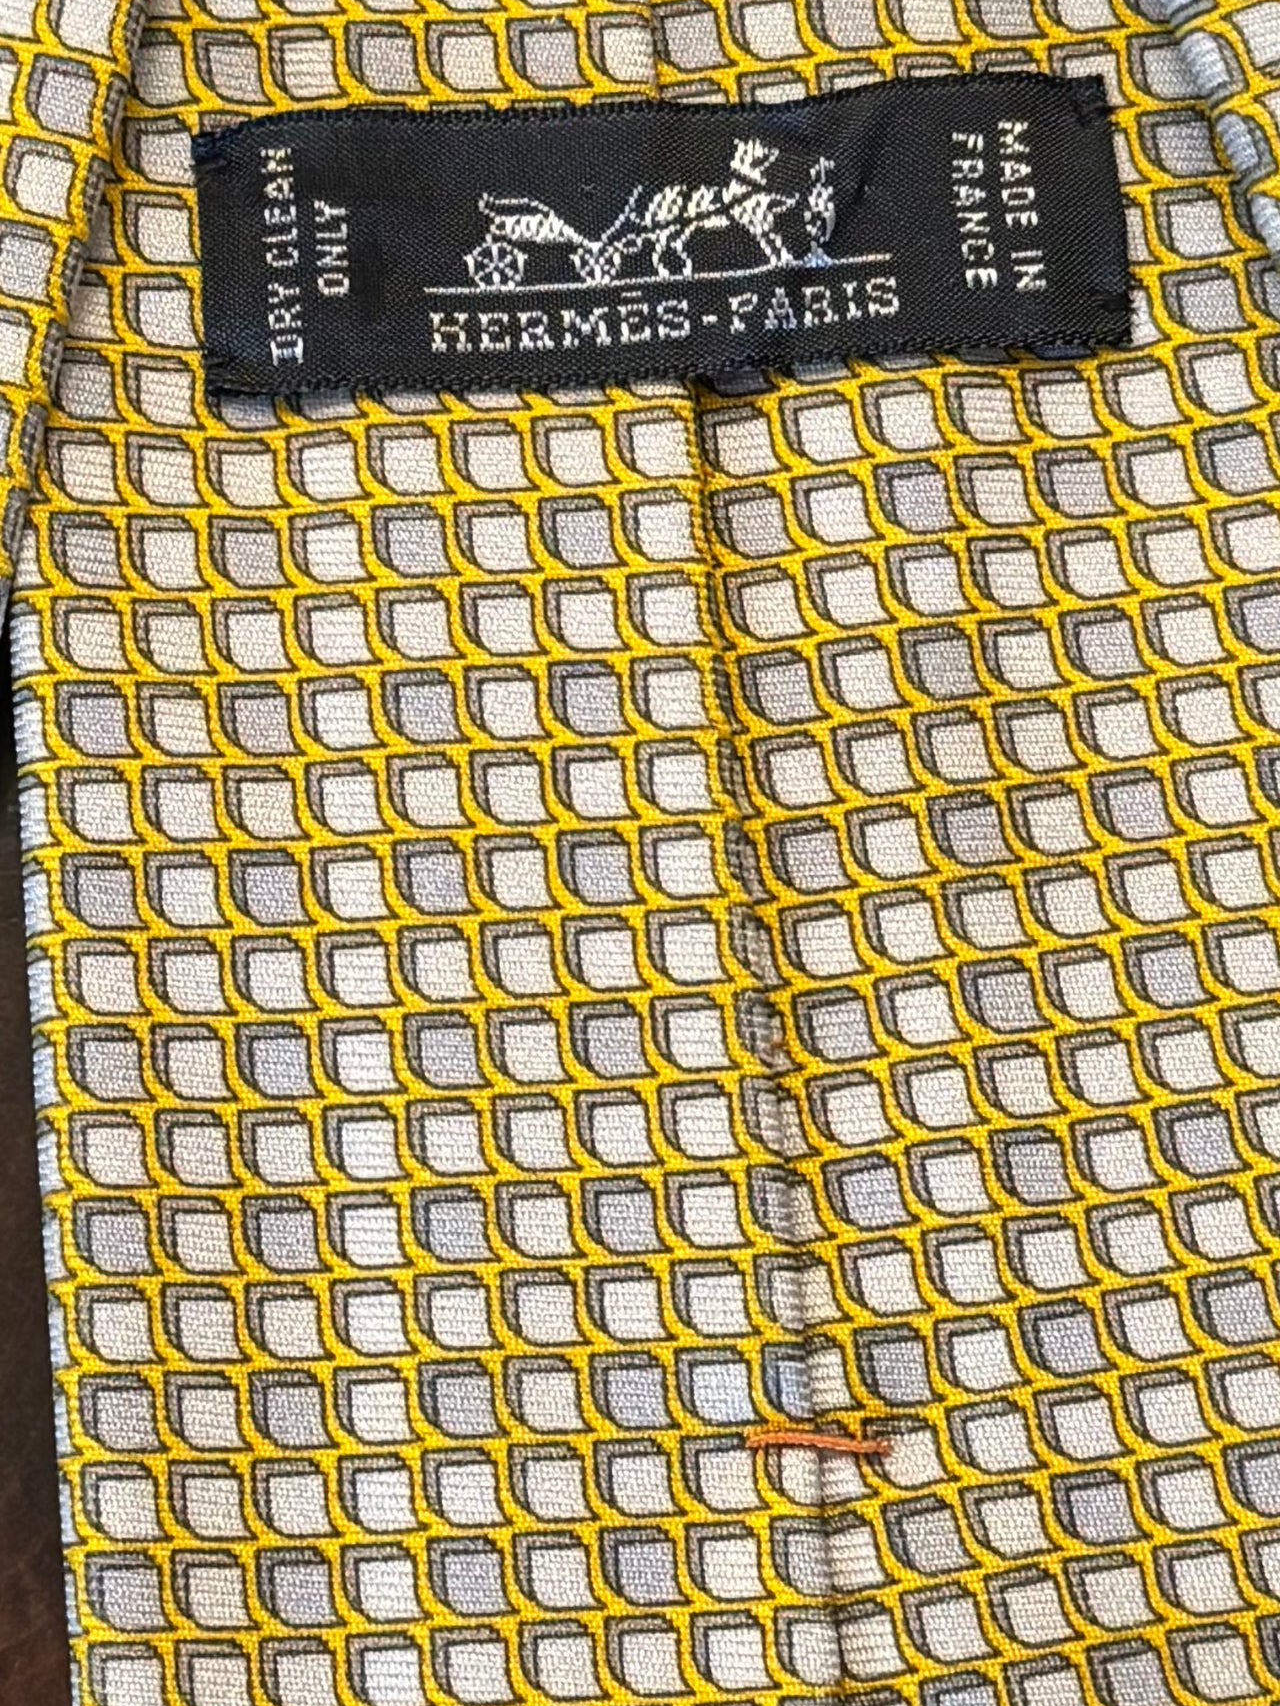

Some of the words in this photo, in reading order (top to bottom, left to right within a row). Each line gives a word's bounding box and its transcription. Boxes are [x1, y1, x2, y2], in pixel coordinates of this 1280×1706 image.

[259, 147, 300, 268] CLEAN
[949, 131, 999, 290] FRANCE
[997, 119, 1039, 228] MADE
[313, 199, 350, 297] ONLY
[1010, 249, 1048, 292] IN
[267, 282, 304, 366] DRY
